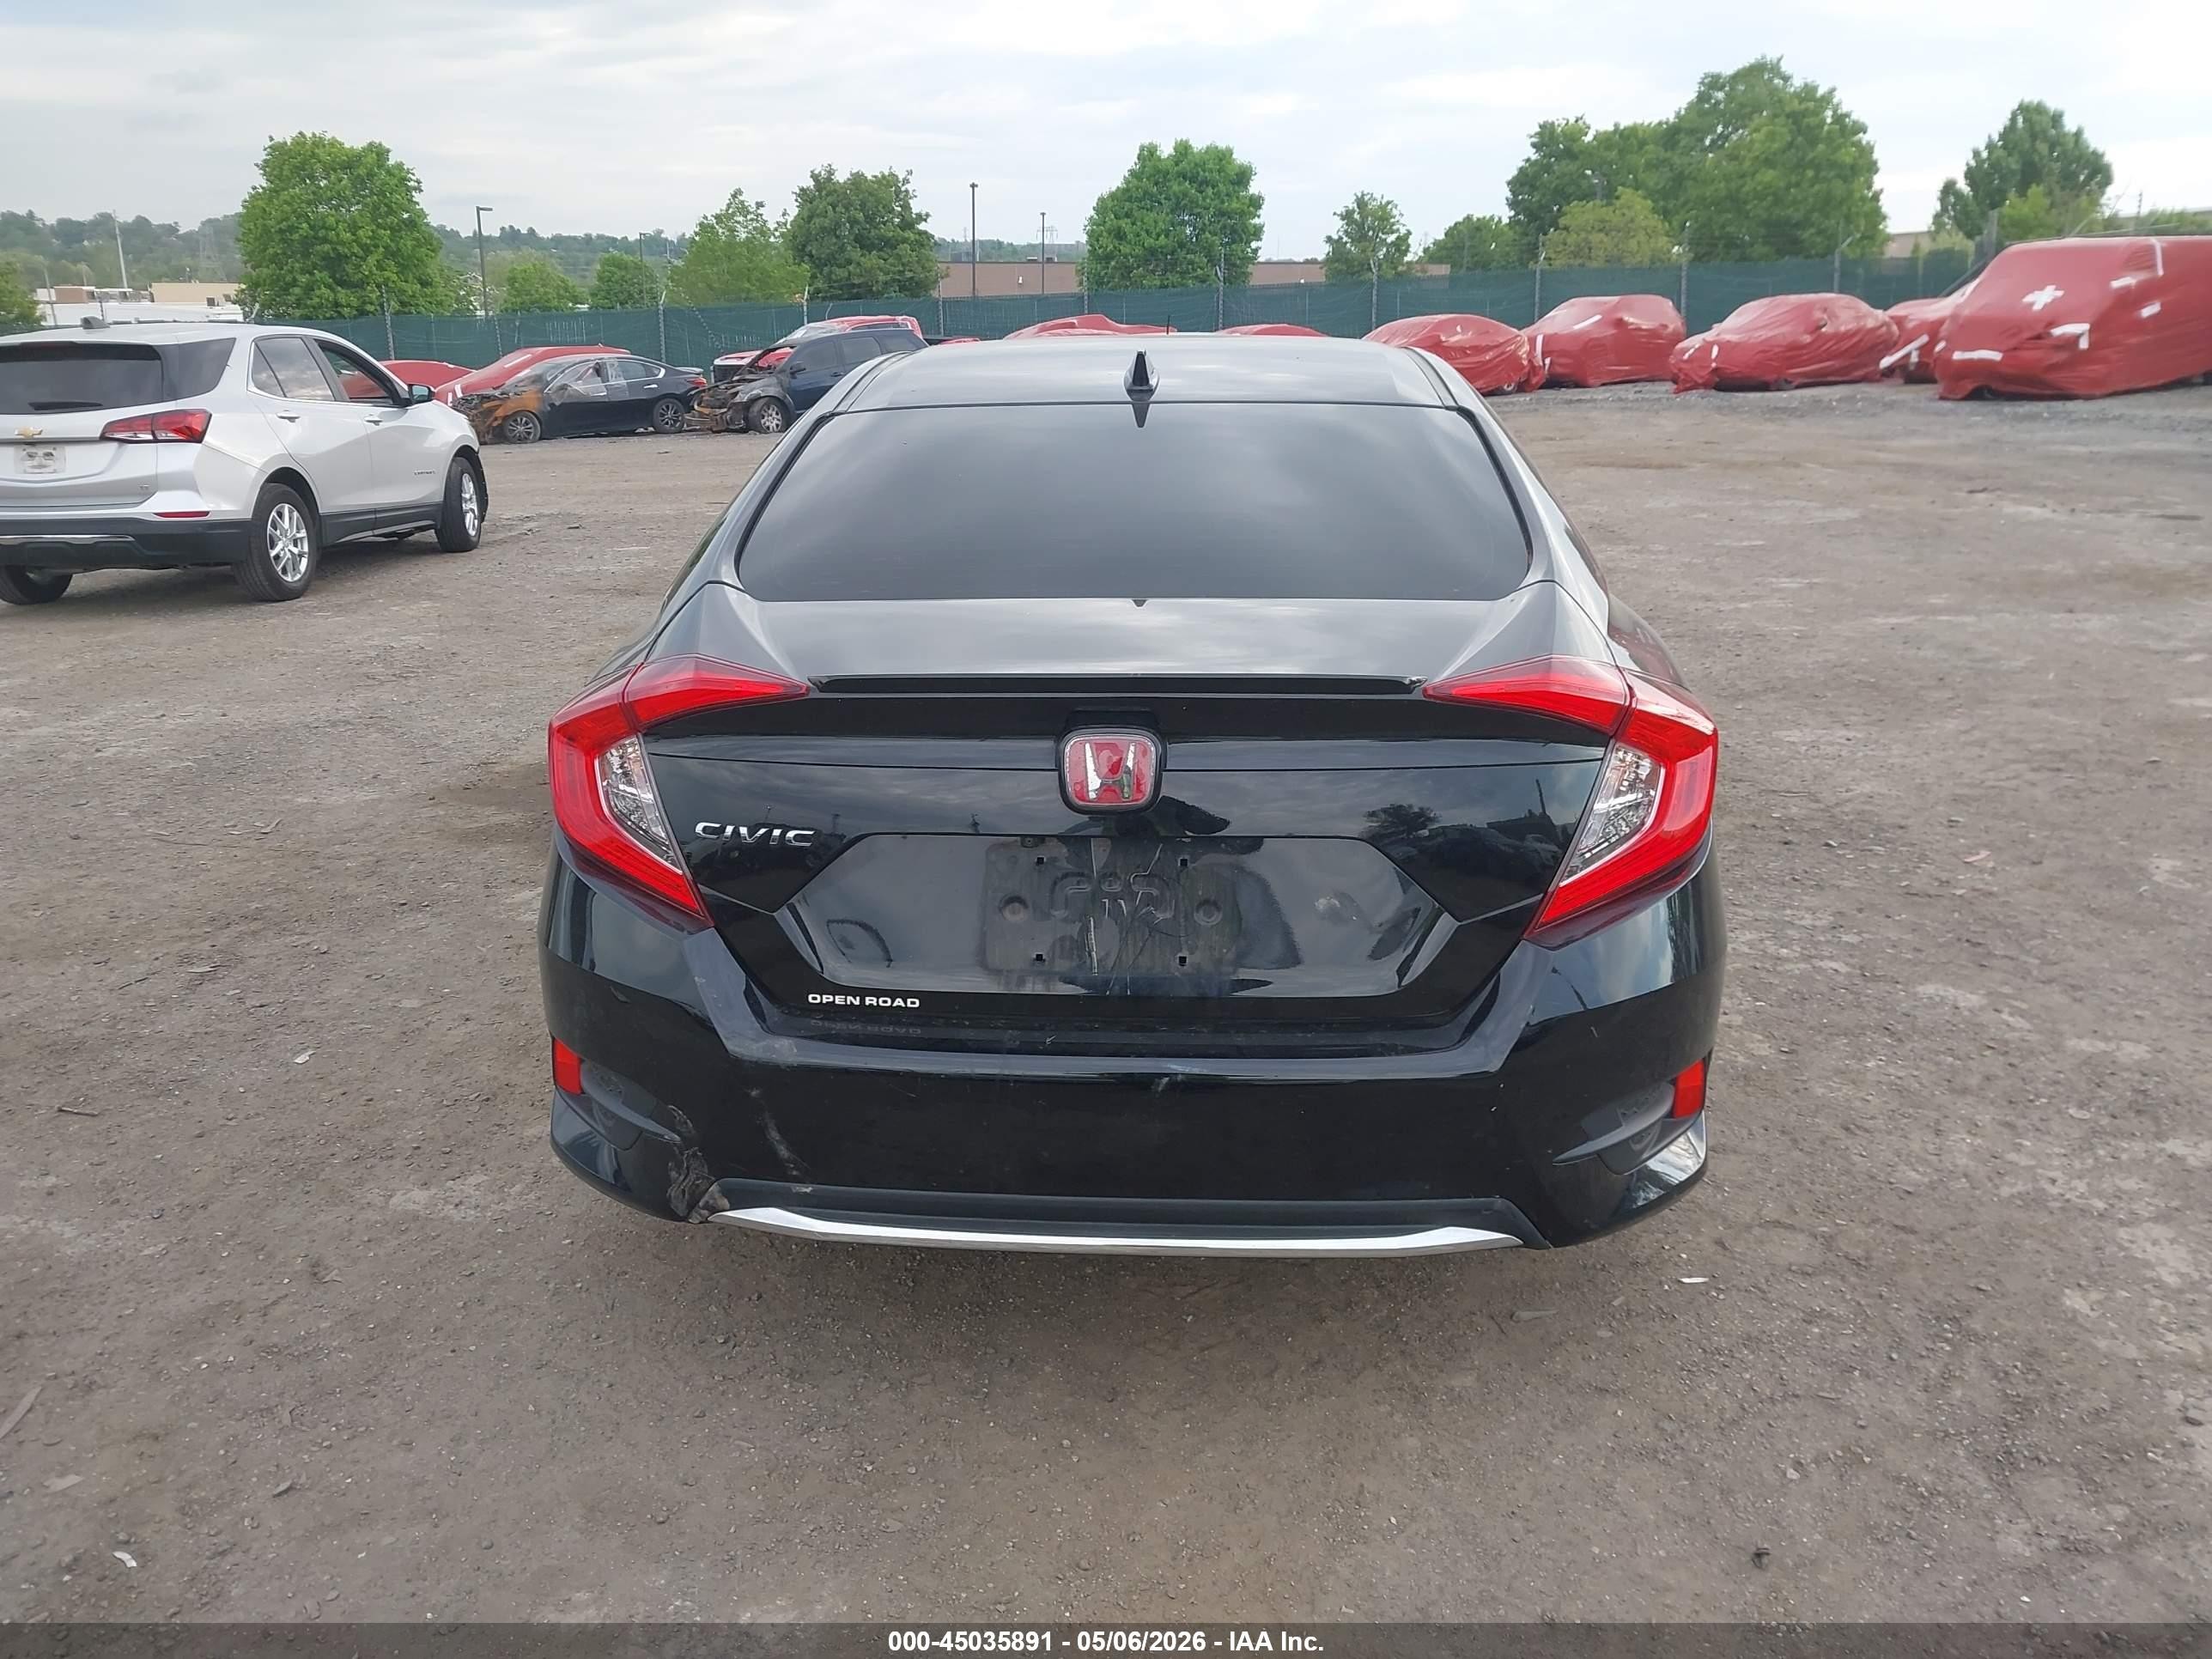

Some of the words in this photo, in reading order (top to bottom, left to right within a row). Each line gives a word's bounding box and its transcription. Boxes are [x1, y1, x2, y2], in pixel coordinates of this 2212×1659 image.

[695, 822, 816, 848] CIVIC
[807, 994, 860, 1006] OPEN
[865, 996, 921, 1008] ROAD
